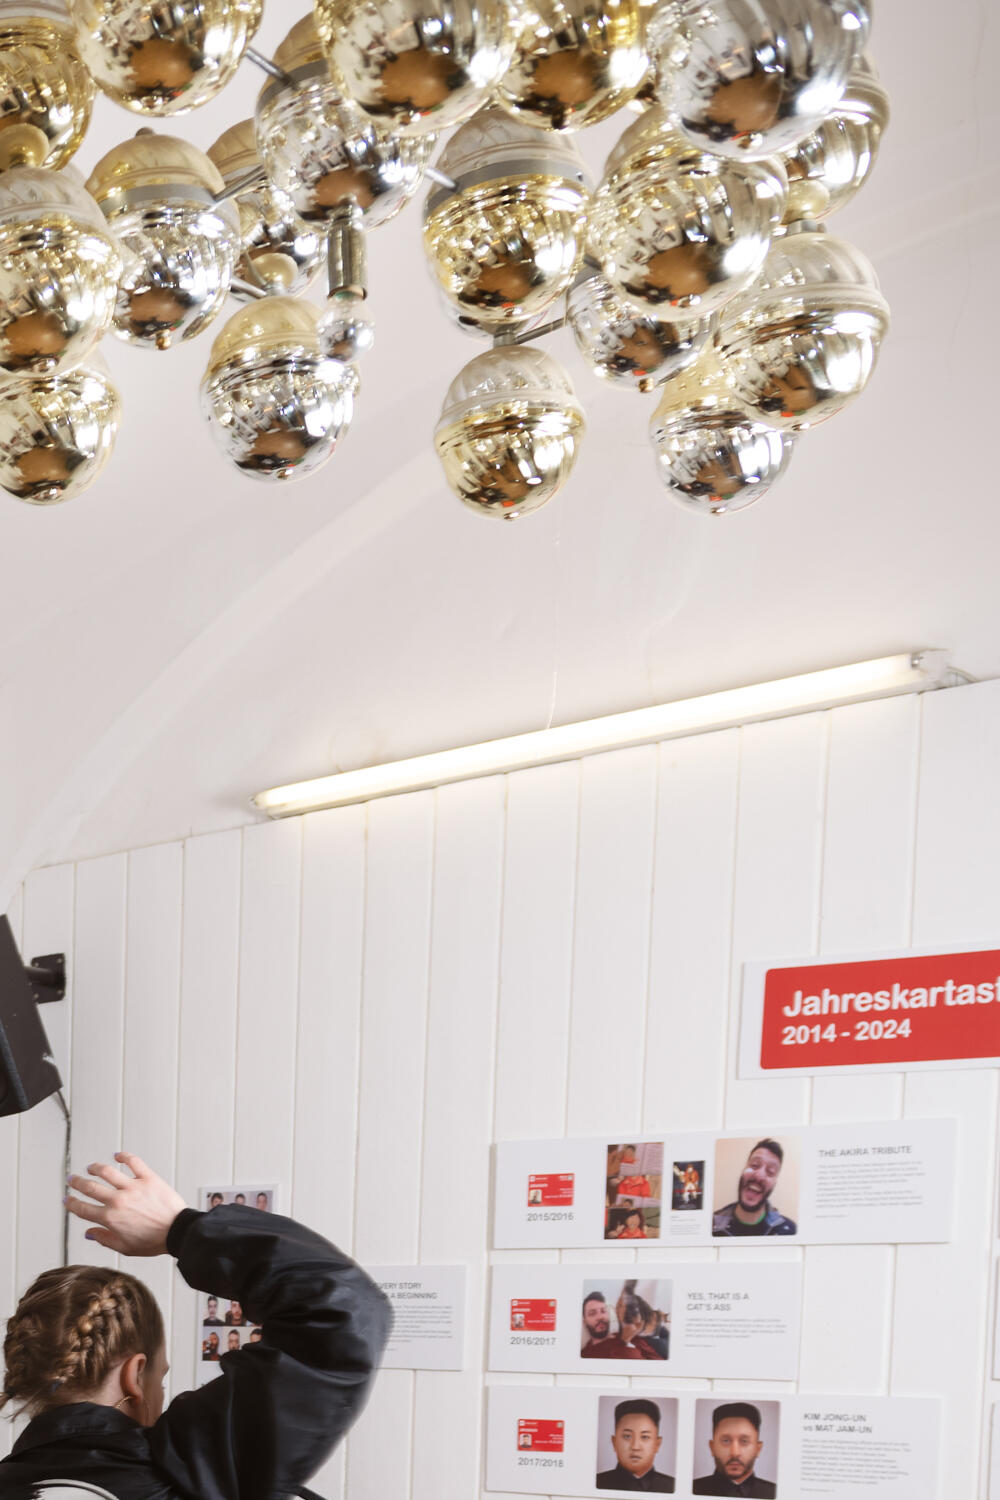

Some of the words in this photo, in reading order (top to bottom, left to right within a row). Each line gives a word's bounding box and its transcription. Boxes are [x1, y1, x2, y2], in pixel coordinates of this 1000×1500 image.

[781, 1023, 837, 1045] 2014
[854, 1018, 912, 1041] 2024
[818, 1149, 837, 1158] THE
[839, 1148, 869, 1157] AKIRA
[871, 1145, 912, 1155] TRIBUTE
[527, 1213, 574, 1222] 2015/2016
[397, 1292, 437, 1300] BEGINNING
[708, 1292, 730, 1300] THAT
[713, 1303, 731, 1311] ASS
[510, 1337, 556, 1346] 2016/2017
[803, 1412, 820, 1420] KIM
[822, 1413, 866, 1422] JONG-UN
[815, 1424, 834, 1432] MAT
[836, 1425, 872, 1434] JAM-UN
[517, 1457, 564, 1468] 2017/2018
